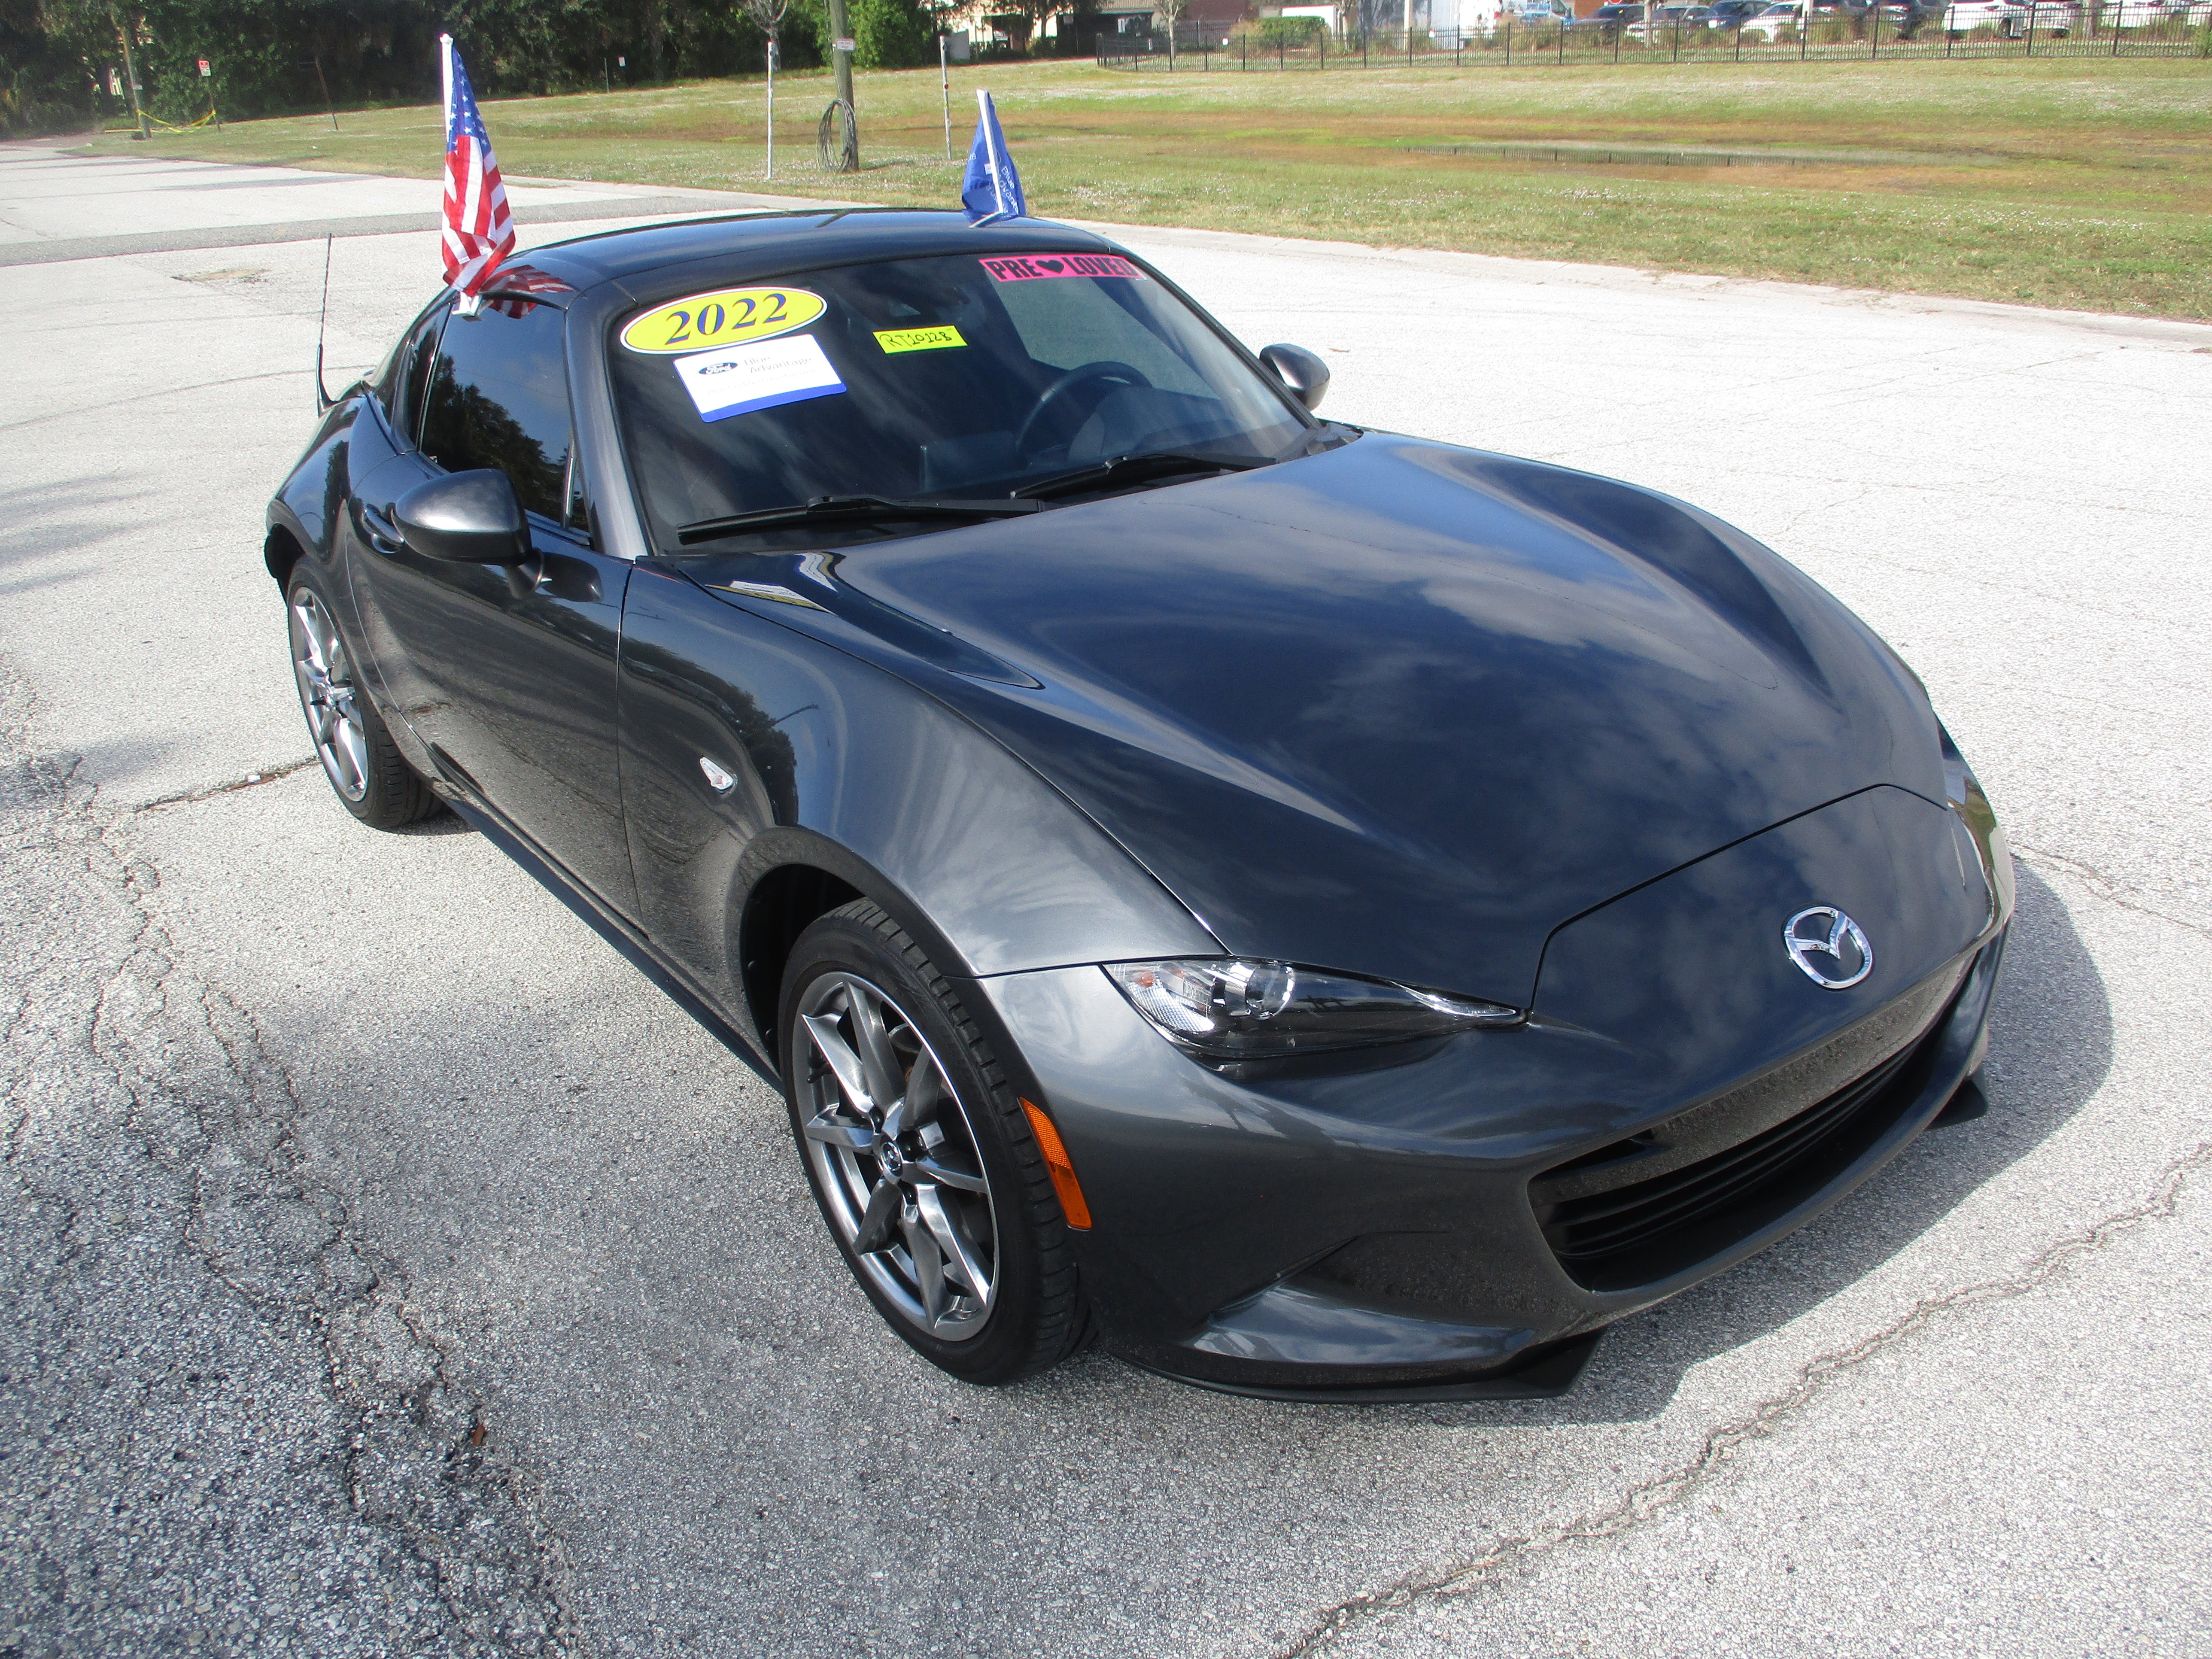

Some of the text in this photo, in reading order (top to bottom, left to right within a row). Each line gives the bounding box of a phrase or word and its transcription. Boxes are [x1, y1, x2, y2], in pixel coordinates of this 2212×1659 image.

[1001, 166, 1015, 190] Blue
[984, 256, 1139, 279] PRE LOVED
[664, 293, 788, 346] 2022
[879, 331, 952, 347] RT10128
[705, 362, 732, 375] Ford
[743, 356, 771, 366] Blue
[750, 357, 812, 374] Advantage
